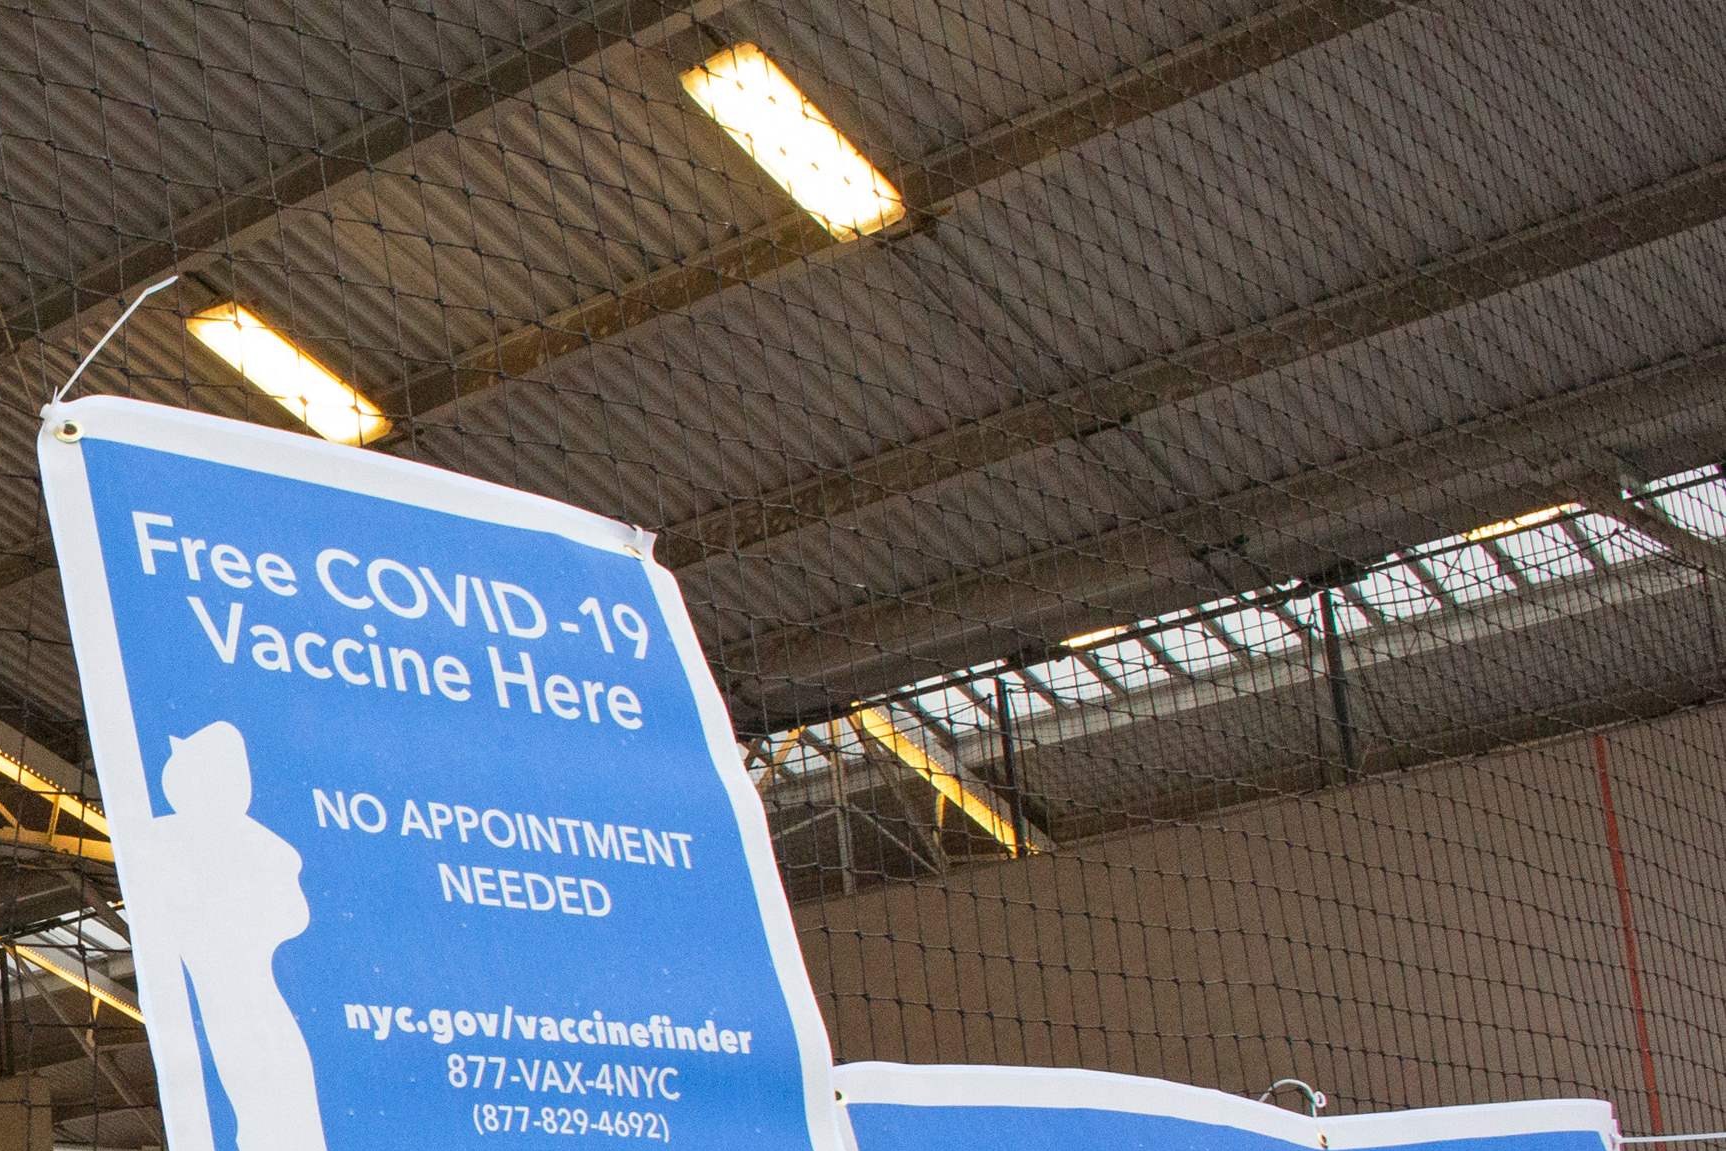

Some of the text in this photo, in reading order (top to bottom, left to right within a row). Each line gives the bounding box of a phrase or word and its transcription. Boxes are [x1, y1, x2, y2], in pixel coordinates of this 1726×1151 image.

[131, 510, 650, 660] Free COVID -19
[186, 596, 643, 730] Vaccine Here
[312, 788, 693, 870] NO APPOINTMENT
[437, 863, 613, 917] NEEDED
[344, 1003, 752, 1054] nyc.gov/vaccinefinder
[447, 1053, 681, 1101] 877-VAX-4NYC
[473, 1103, 670, 1143] (877-829-4692)
